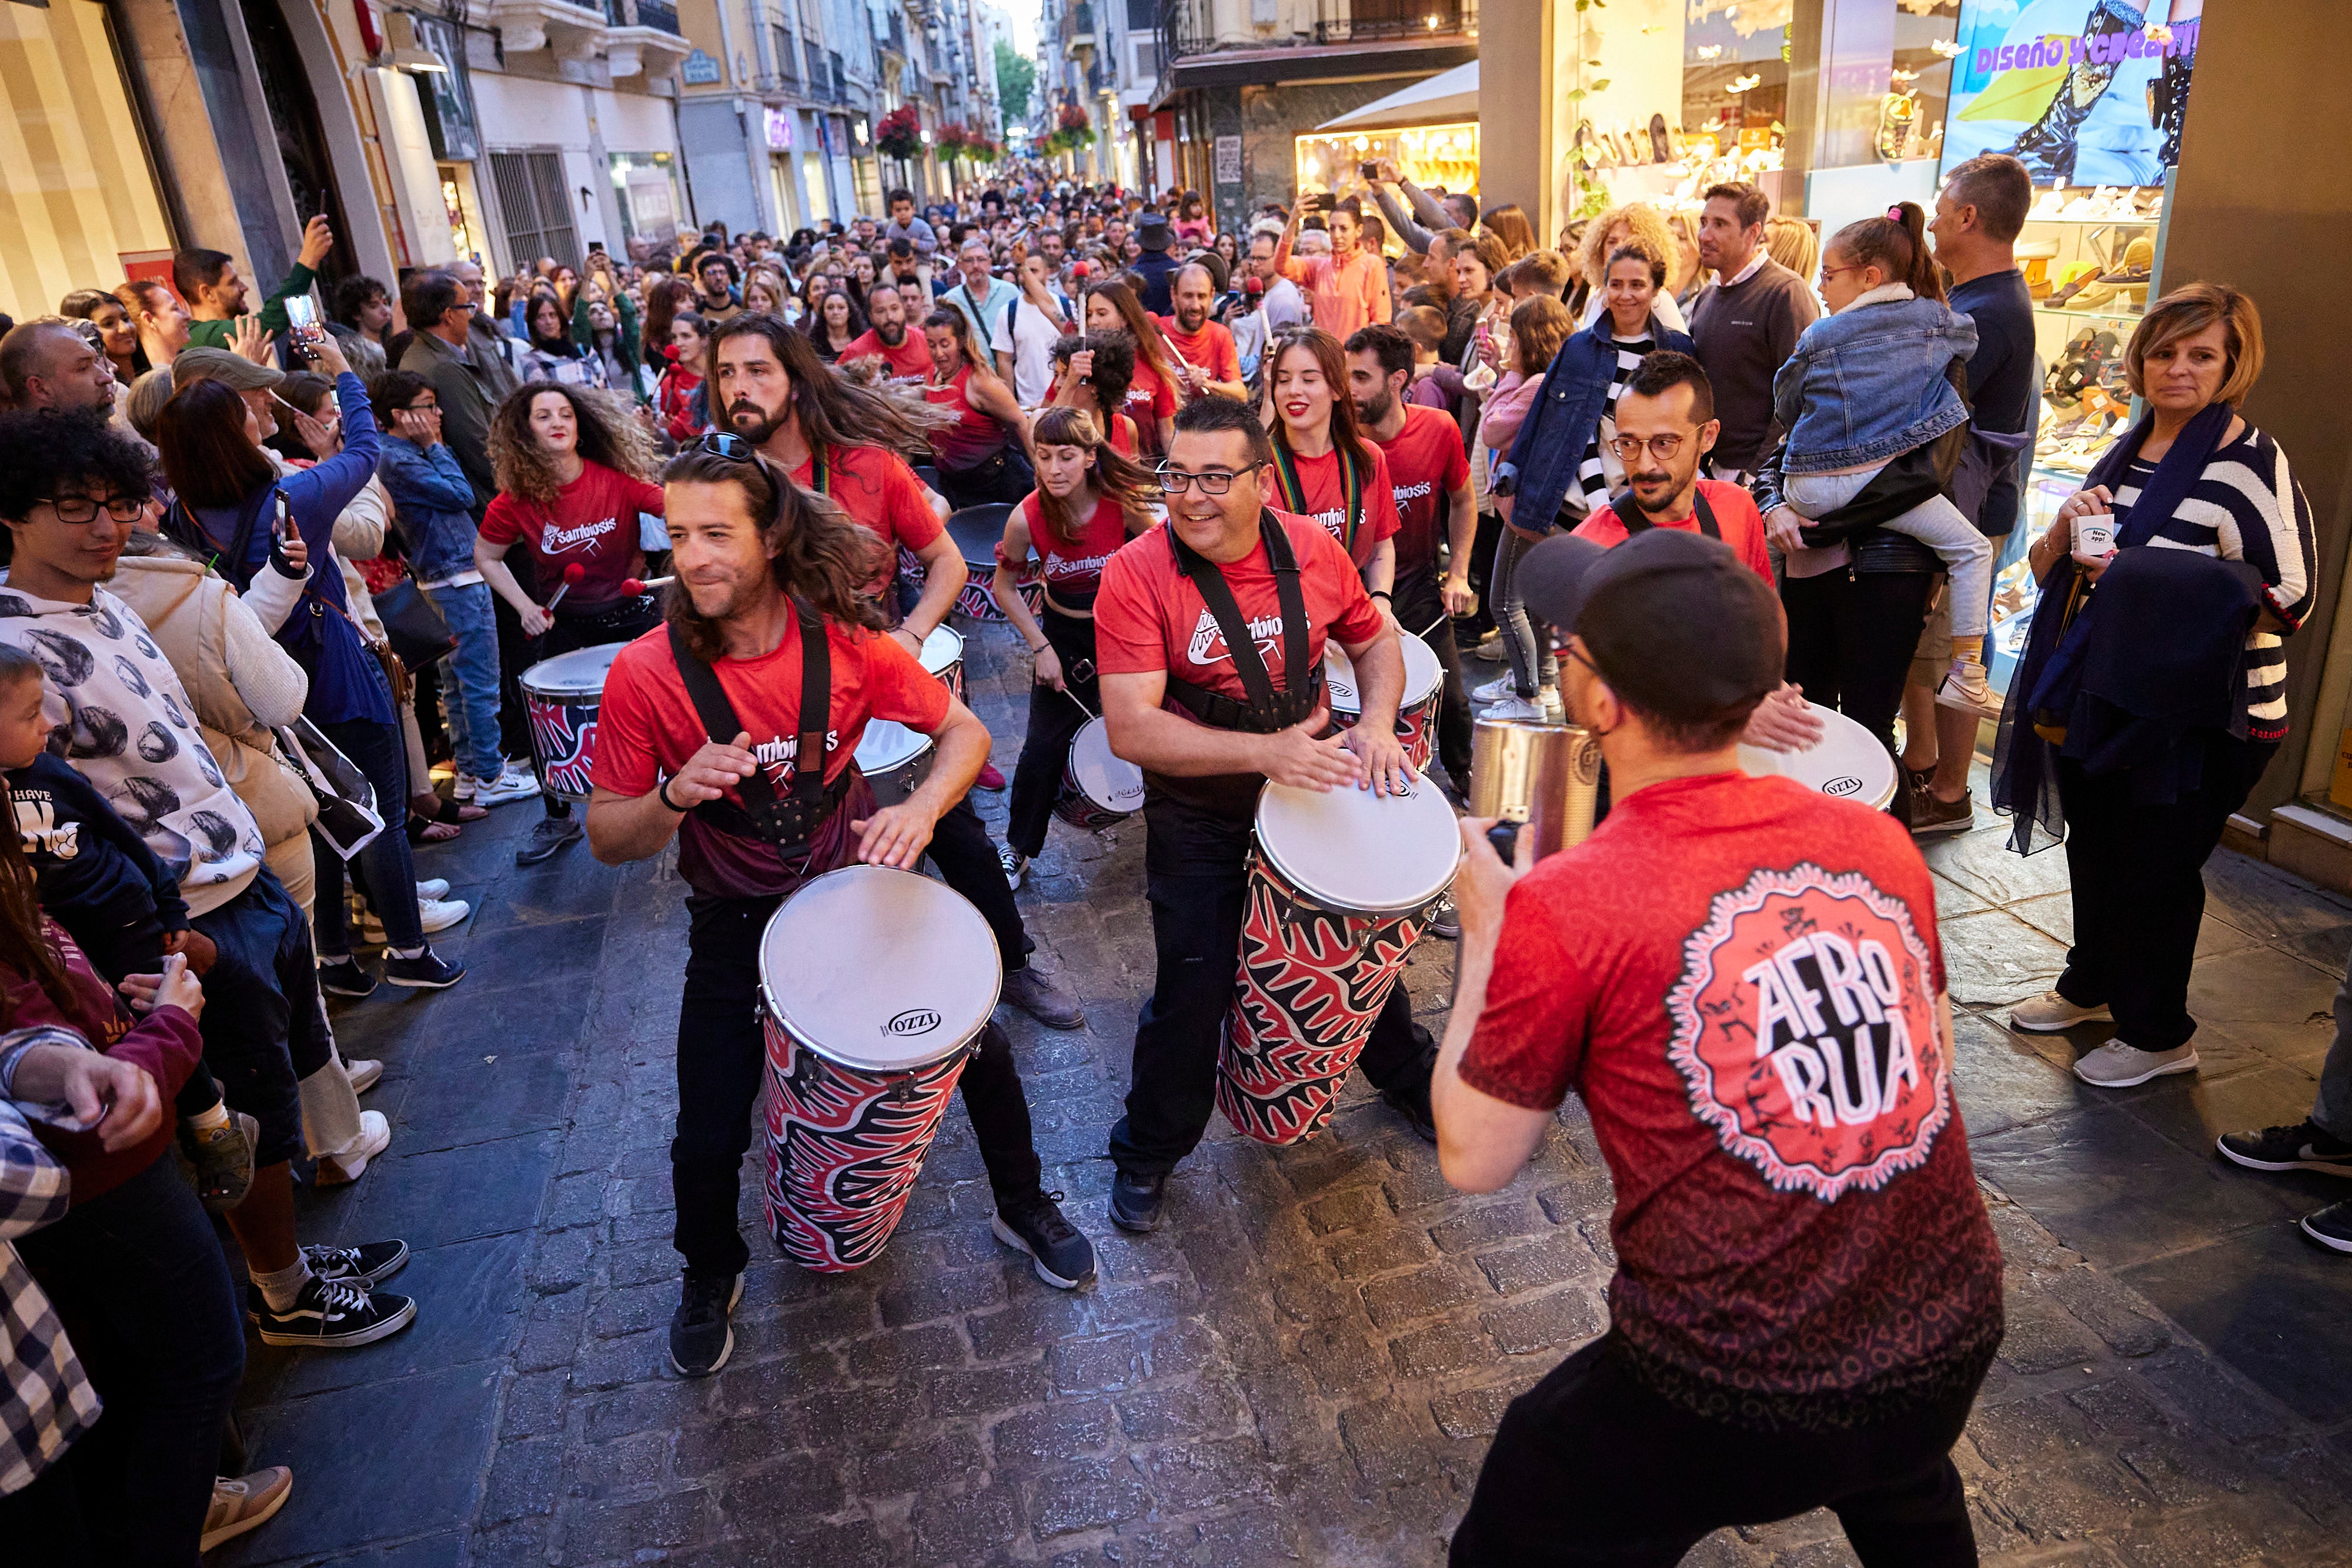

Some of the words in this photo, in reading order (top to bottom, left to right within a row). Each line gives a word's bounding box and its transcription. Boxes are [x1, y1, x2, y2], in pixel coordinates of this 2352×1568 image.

[14, 790, 52, 801] HAVE
[1827, 778, 1858, 794] IZZO
[1742, 931, 1900, 1059] AFRO
[894, 1012, 936, 1032] IZZO
[1771, 1008, 1919, 1128] RUA
